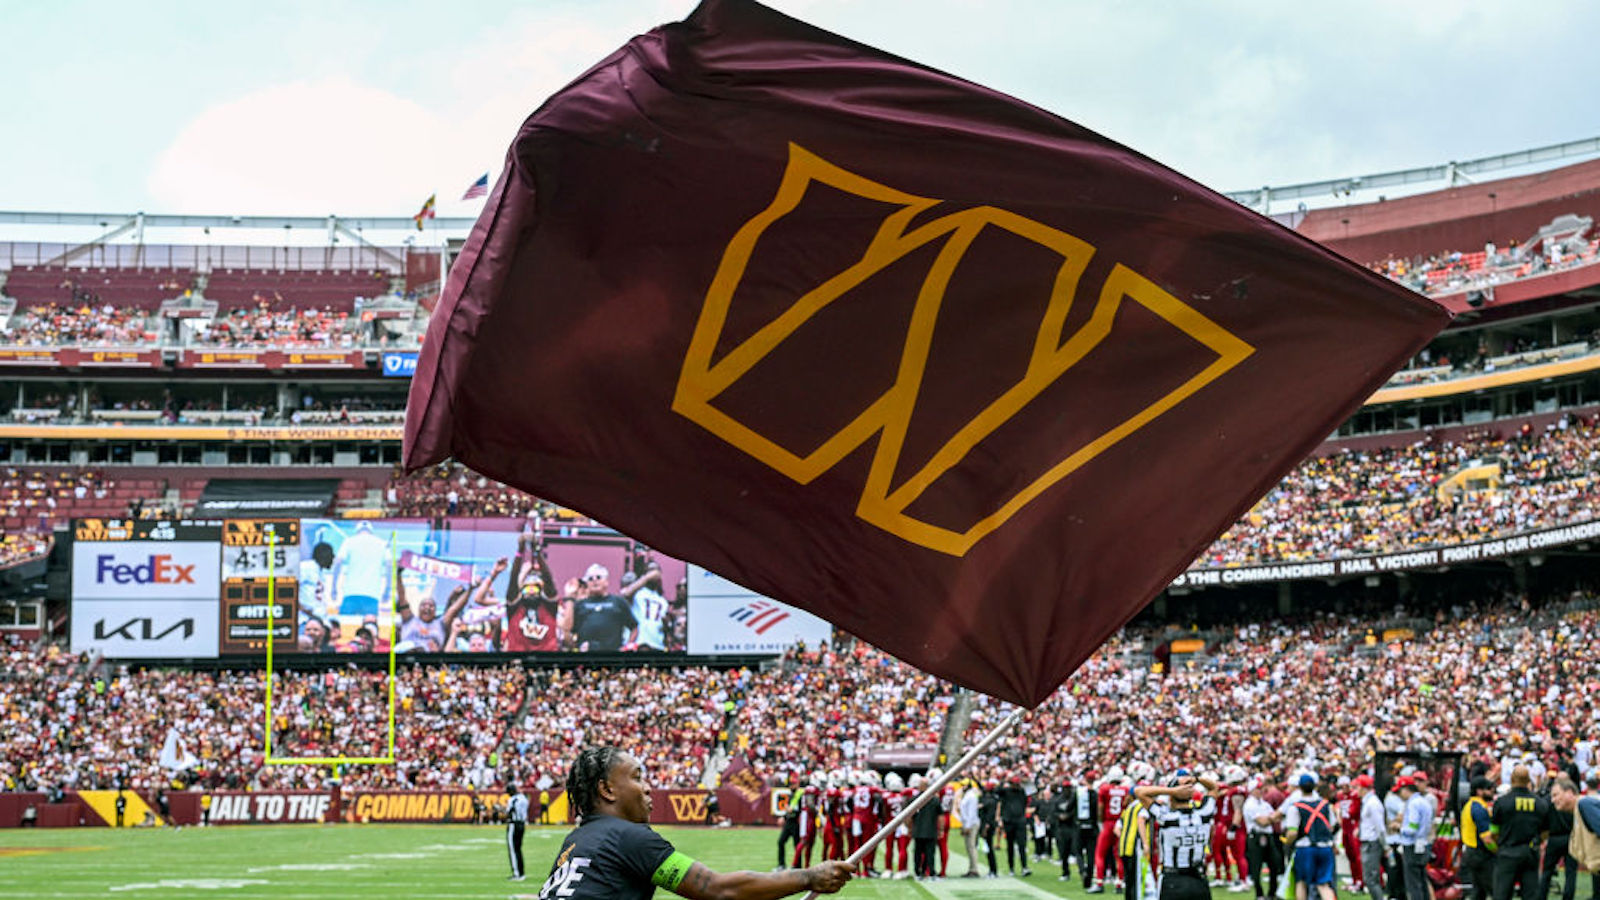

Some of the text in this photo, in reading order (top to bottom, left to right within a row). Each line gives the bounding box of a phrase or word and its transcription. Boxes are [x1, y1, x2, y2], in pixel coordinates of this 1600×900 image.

[242, 429, 283, 438] TIME
[288, 429, 349, 438] WORLD
[354, 429, 404, 438] CHAM
[235, 548, 286, 569] 4:15
[1187, 571, 1220, 584] THE
[1222, 562, 1335, 583] COMMANDERS!
[1340, 558, 1375, 574] HAIL
[1377, 551, 1438, 571] VICTORY!
[1442, 544, 1480, 562] FIGHT
[1483, 541, 1503, 557] FOR
[1506, 537, 1528, 553] OUR
[96, 554, 195, 585] FedEx
[644, 598, 662, 621] 17
[714, 643, 741, 651] BANK
[744, 643, 756, 651] OF
[255, 795, 285, 820] TO
[1109, 796, 1122, 815] 9
[1515, 797, 1536, 812] FIT
